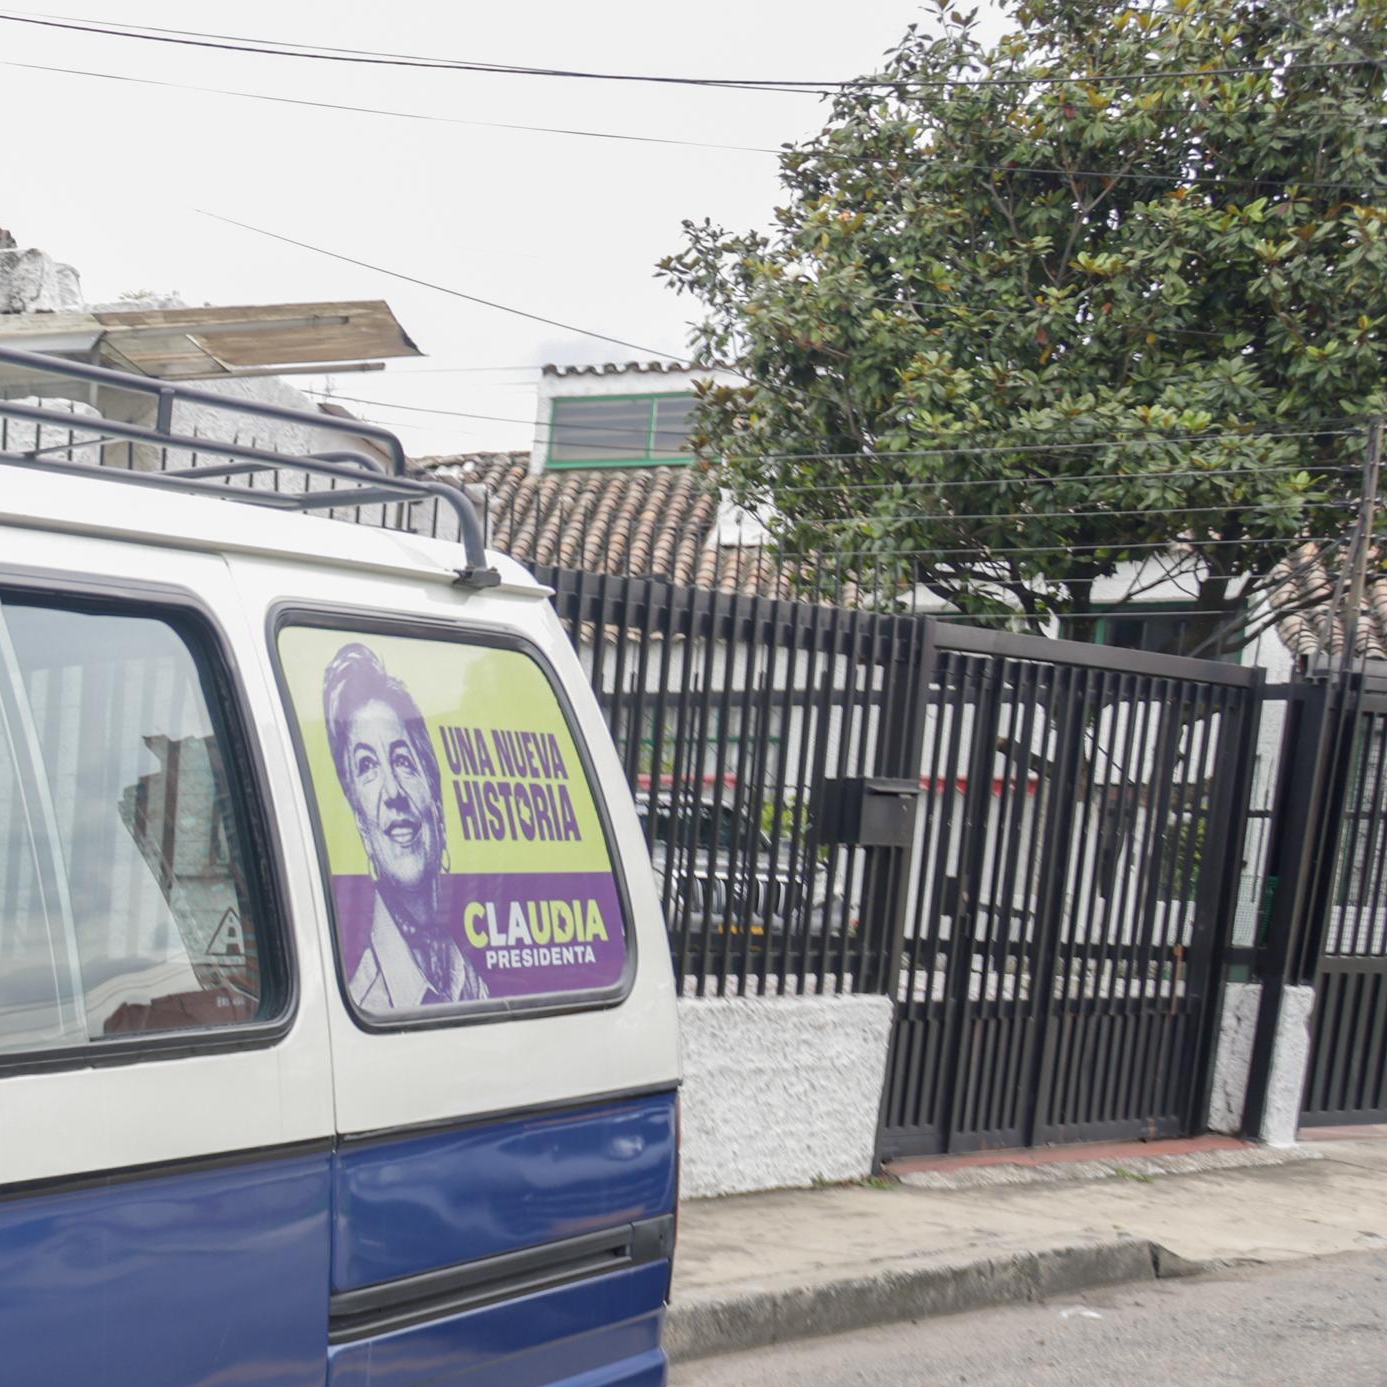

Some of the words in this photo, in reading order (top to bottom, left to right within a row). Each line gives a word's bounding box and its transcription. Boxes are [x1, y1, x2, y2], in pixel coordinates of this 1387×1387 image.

[438, 725, 495, 777] UNA
[492, 728, 569, 780] NUEVA
[452, 780, 582, 842] HISTORIA
[463, 899, 608, 948] CLAUDIA
[486, 947, 596, 970] PRESIDENTA
